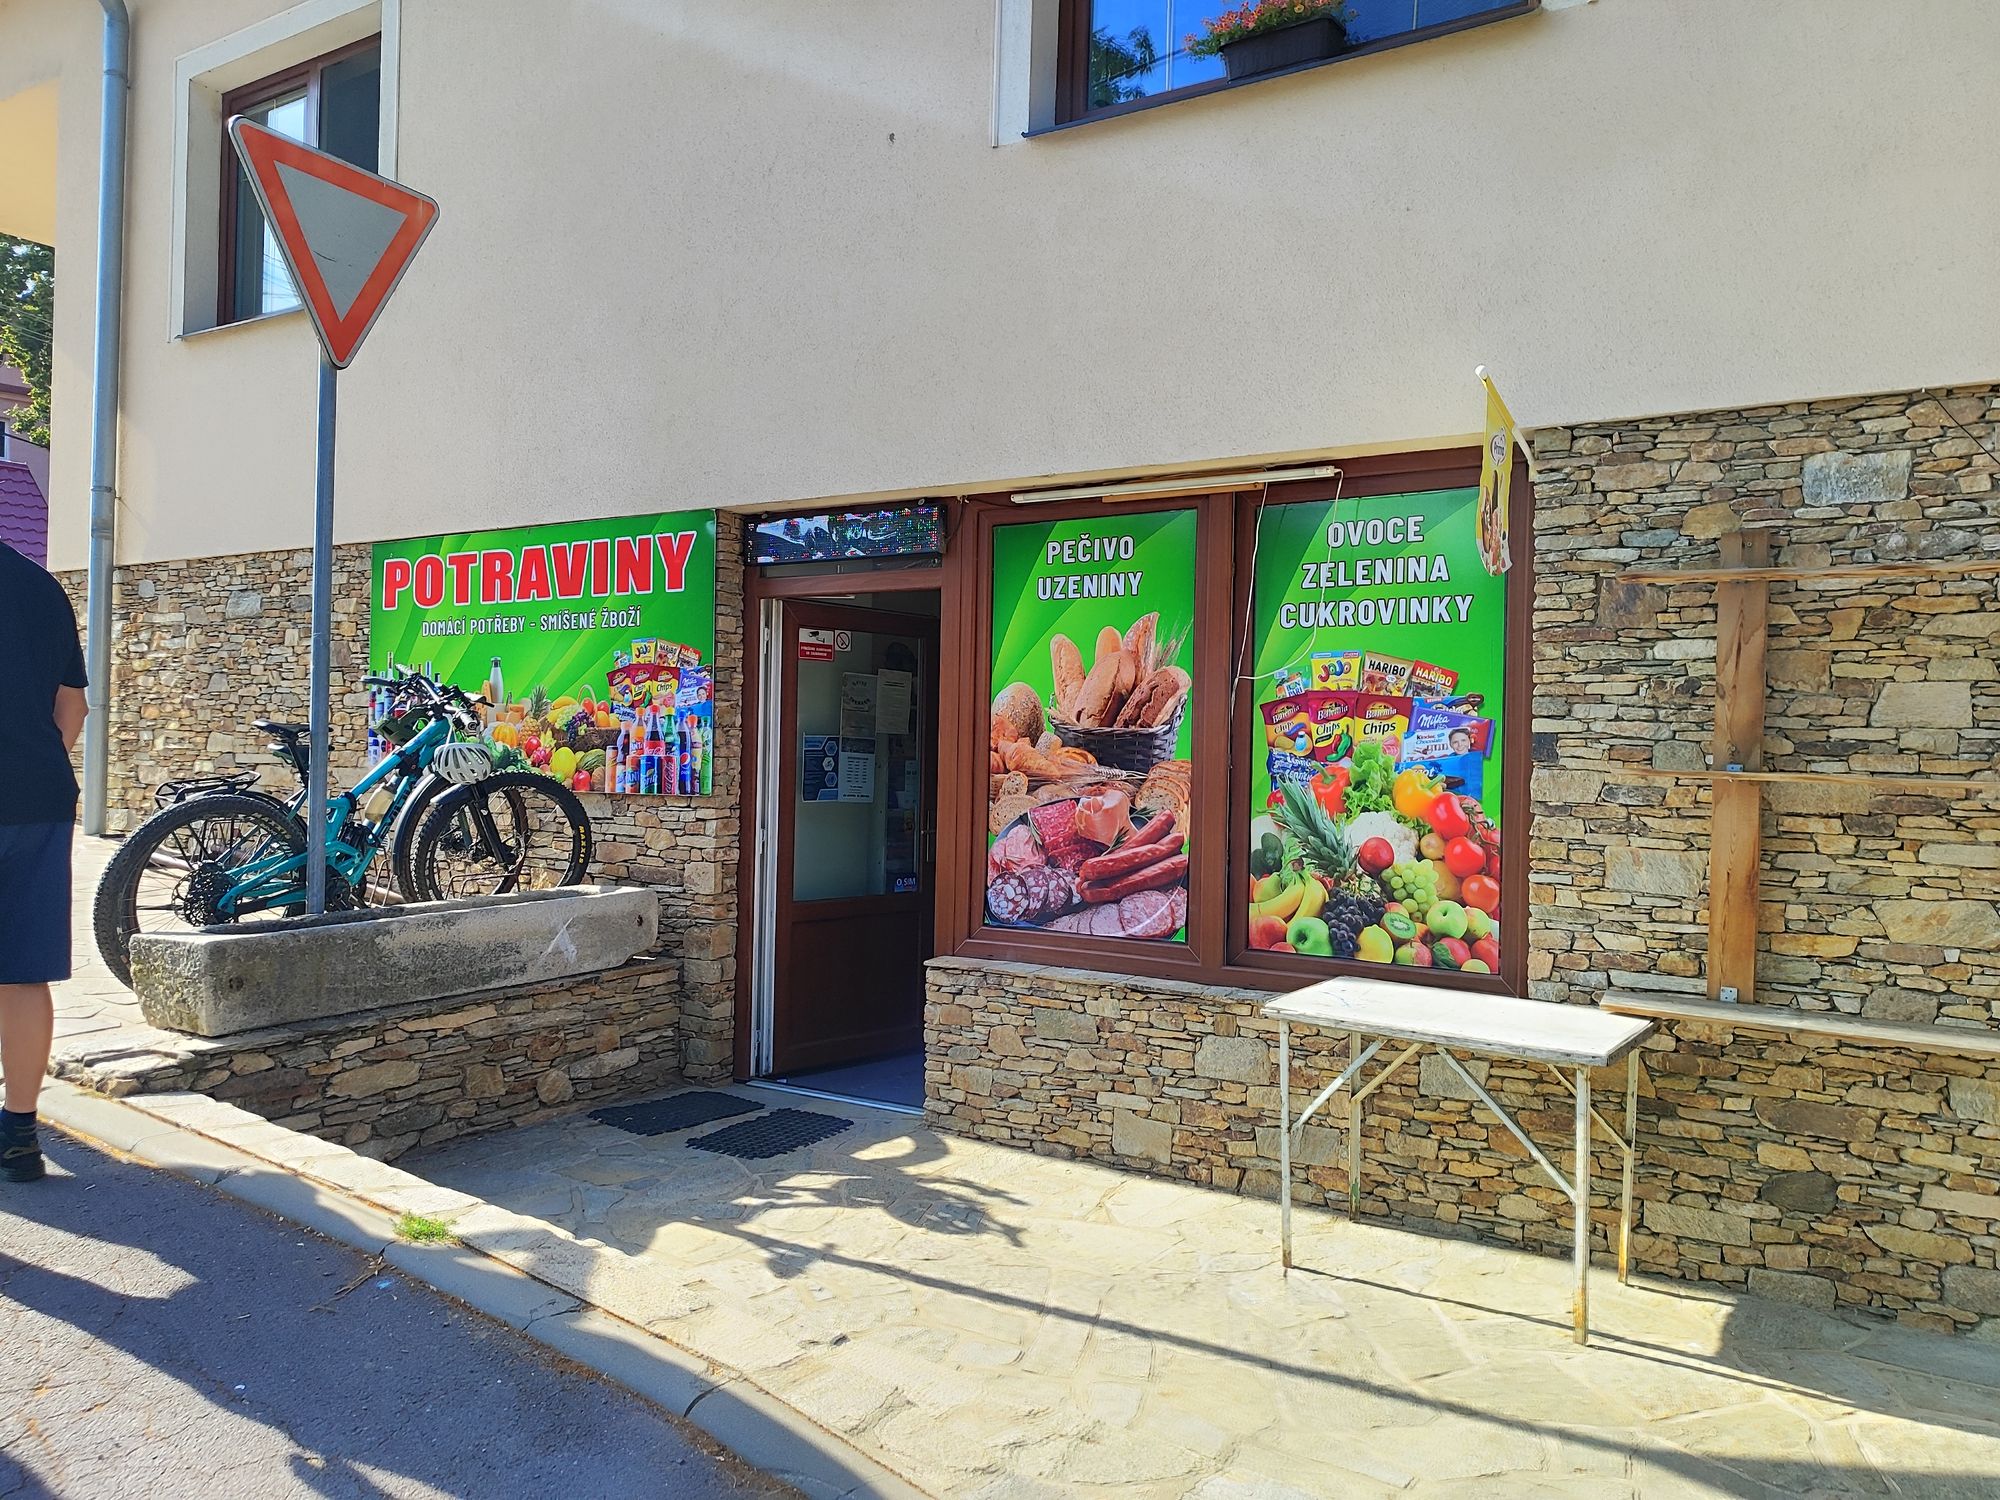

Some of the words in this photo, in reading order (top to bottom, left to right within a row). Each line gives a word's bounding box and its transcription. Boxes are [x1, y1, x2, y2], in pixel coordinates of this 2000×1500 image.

[1326, 515, 1425, 549] OVOCE
[1046, 533, 1135, 566] PEČIVO
[382, 530, 698, 610] POTRAVINY
[1301, 555, 1450, 589] ZELENINA
[1036, 571, 1144, 602] UZENINY
[421, 616, 466, 638] DOMÁCÍ
[470, 613, 525, 636] POTŘEBY
[540, 608, 597, 632] SMÍŠENÉ
[601, 605, 642, 629] ŽBOŽÍ
[1279, 594, 1475, 630] CUKROVINKY
[1368, 659, 1406, 677] HARIBO
[1415, 667, 1452, 687] HARIBO
[1316, 722, 1341, 736] Chips
[1363, 721, 1396, 735] Chips
[1417, 713, 1450, 729] Milka
